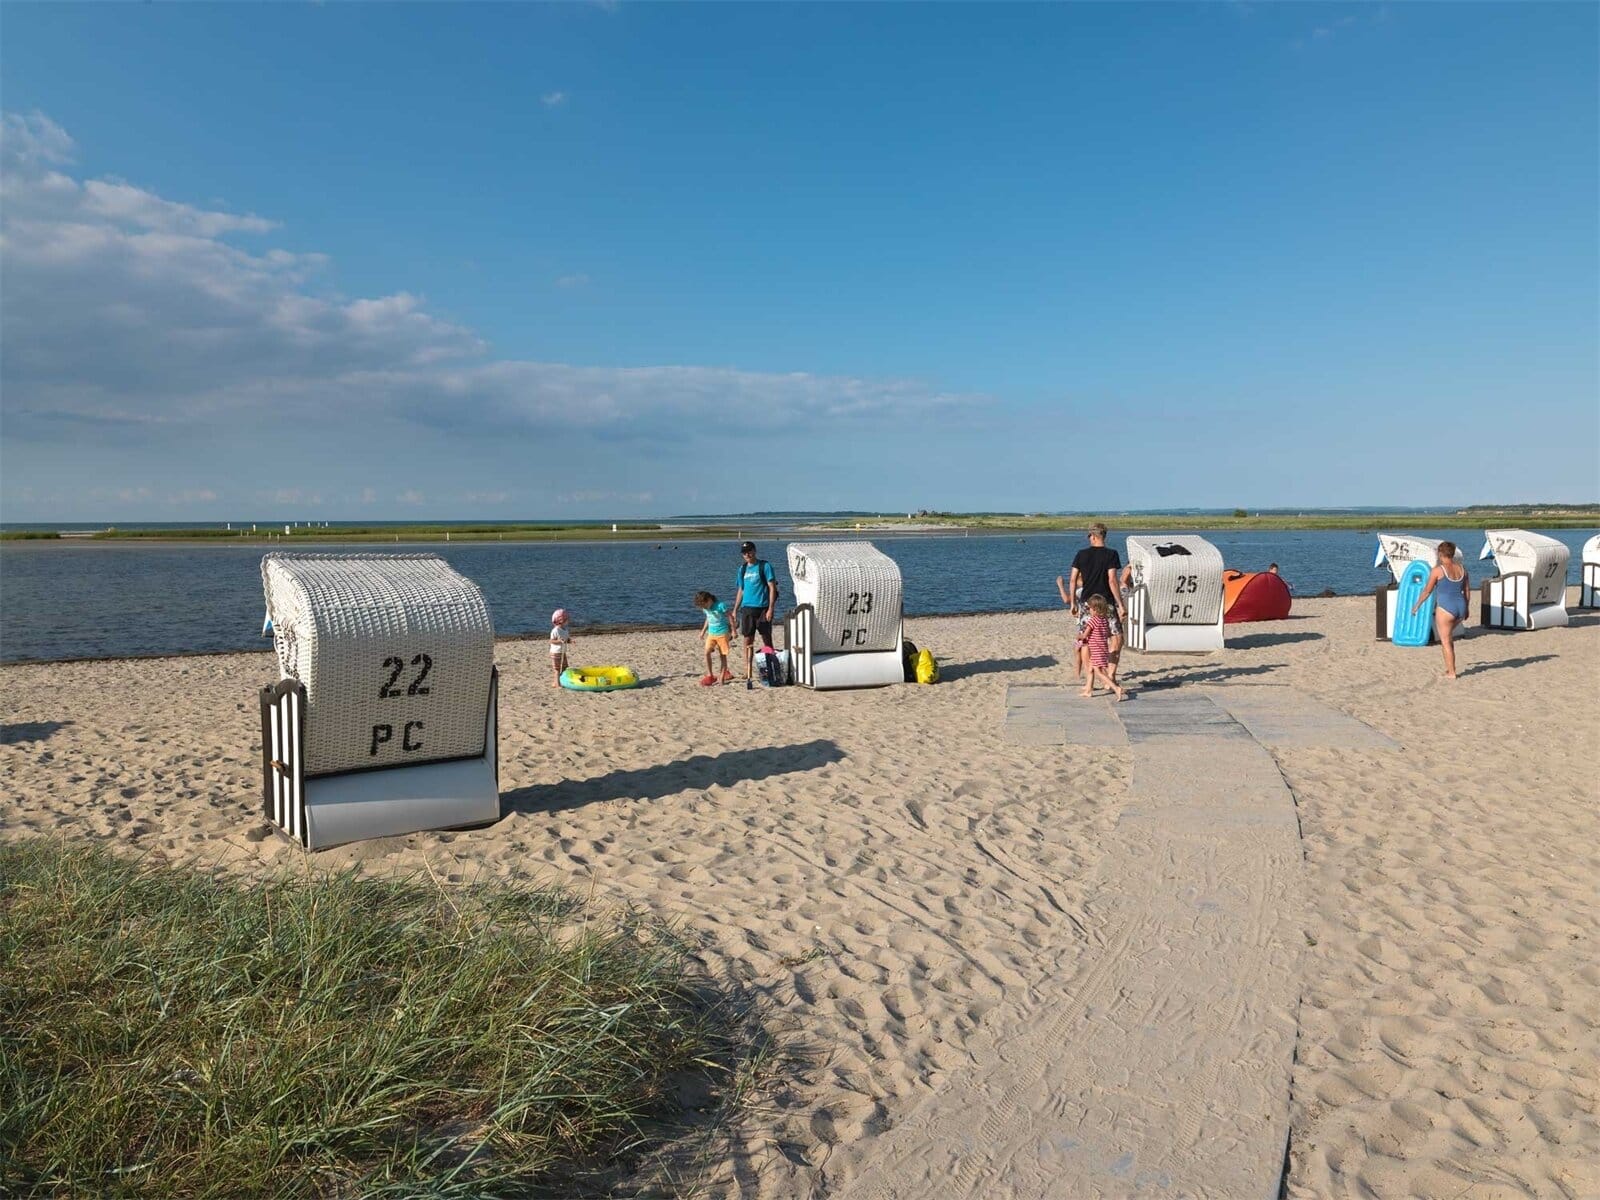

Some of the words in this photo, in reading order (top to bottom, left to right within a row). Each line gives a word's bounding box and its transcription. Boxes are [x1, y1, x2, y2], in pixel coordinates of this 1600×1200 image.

[1389, 541, 1410, 555] 26
[1496, 537, 1515, 555] 27
[1545, 562, 1559, 578] 27
[1175, 575, 1198, 594] 25
[847, 592, 873, 615] 23
[1169, 604, 1192, 619] PC
[840, 628, 867, 647] PC
[379, 653, 432, 698] 22
[370, 721, 424, 756] PC
